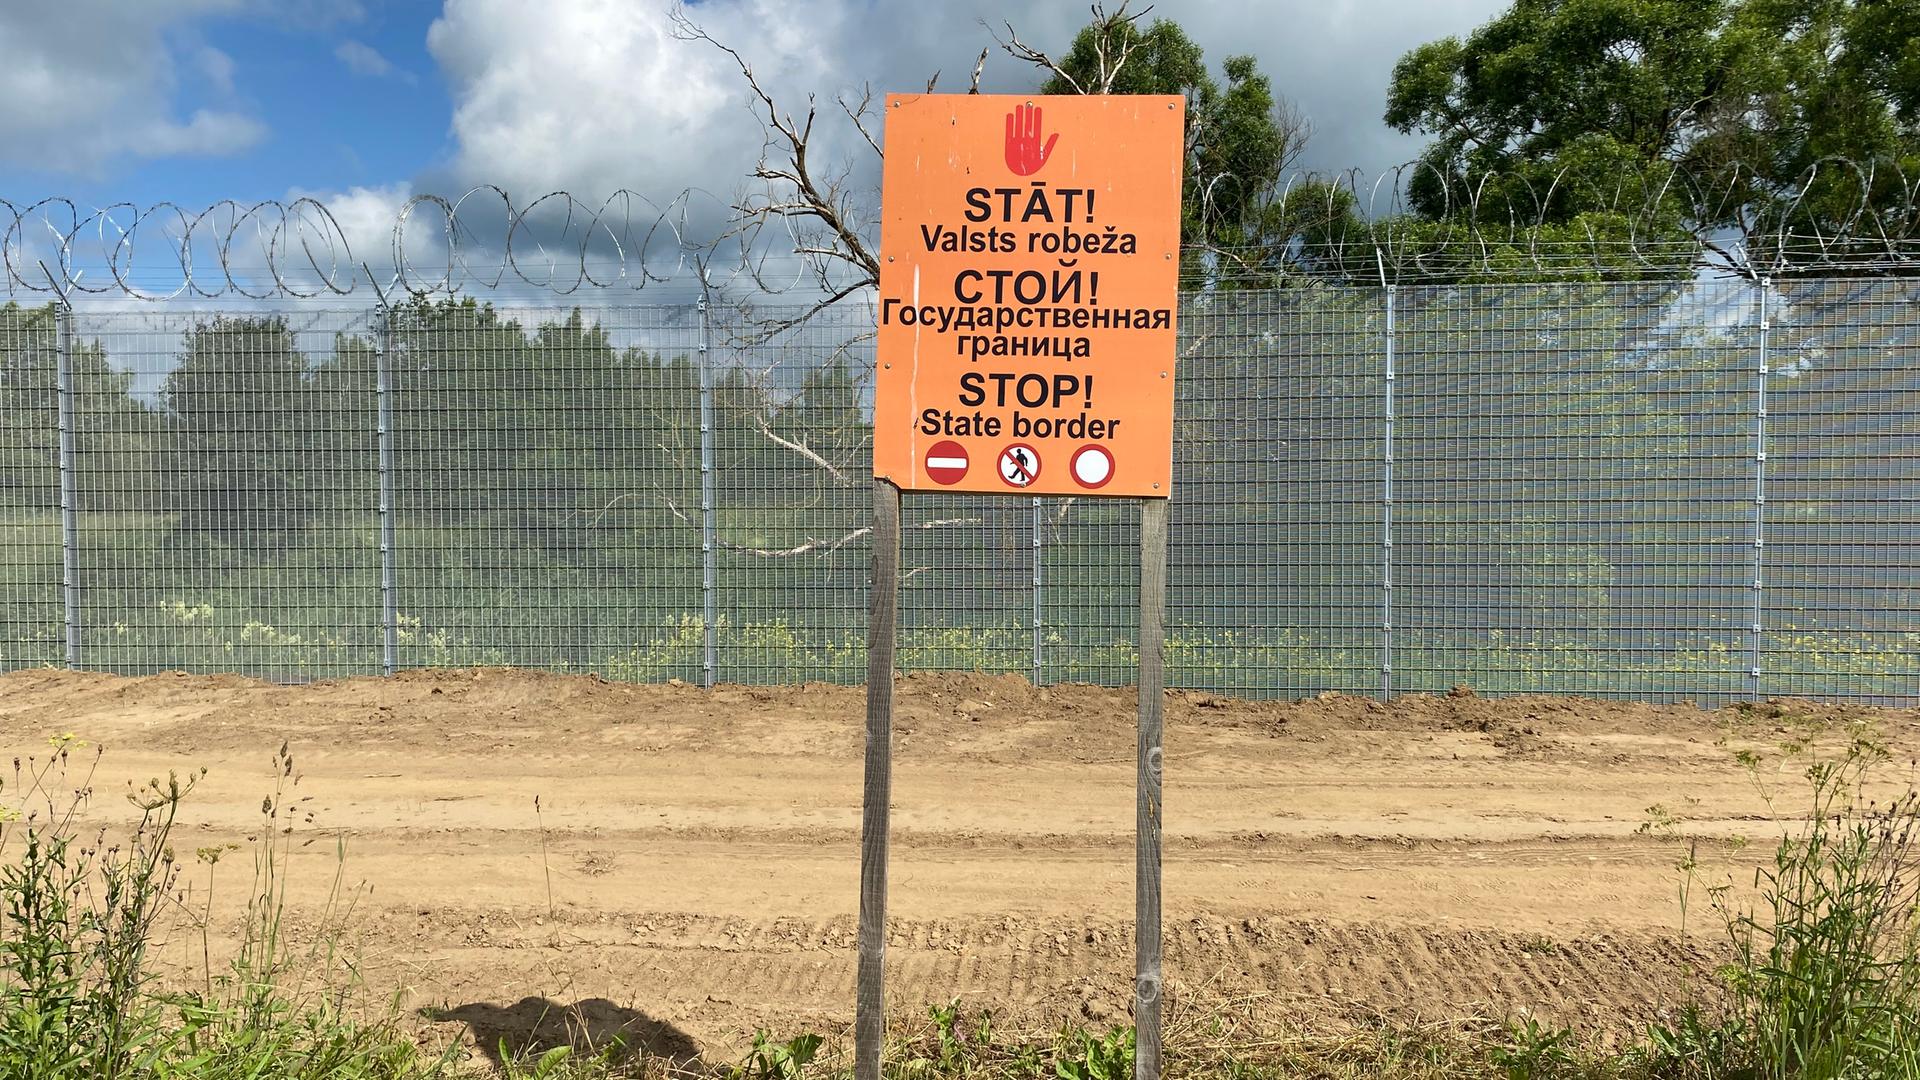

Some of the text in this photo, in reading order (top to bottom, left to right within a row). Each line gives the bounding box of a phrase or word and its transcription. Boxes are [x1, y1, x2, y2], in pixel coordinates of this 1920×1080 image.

[964, 181, 1095, 223] STĀT!
[920, 224, 1137, 254] Valsts robeža
[954, 258, 1099, 306] СТОЙ!
[882, 298, 1171, 334] Государственная
[957, 335, 1091, 362] граница
[958, 372, 1093, 409] STOP!
[921, 408, 1121, 440] State border
